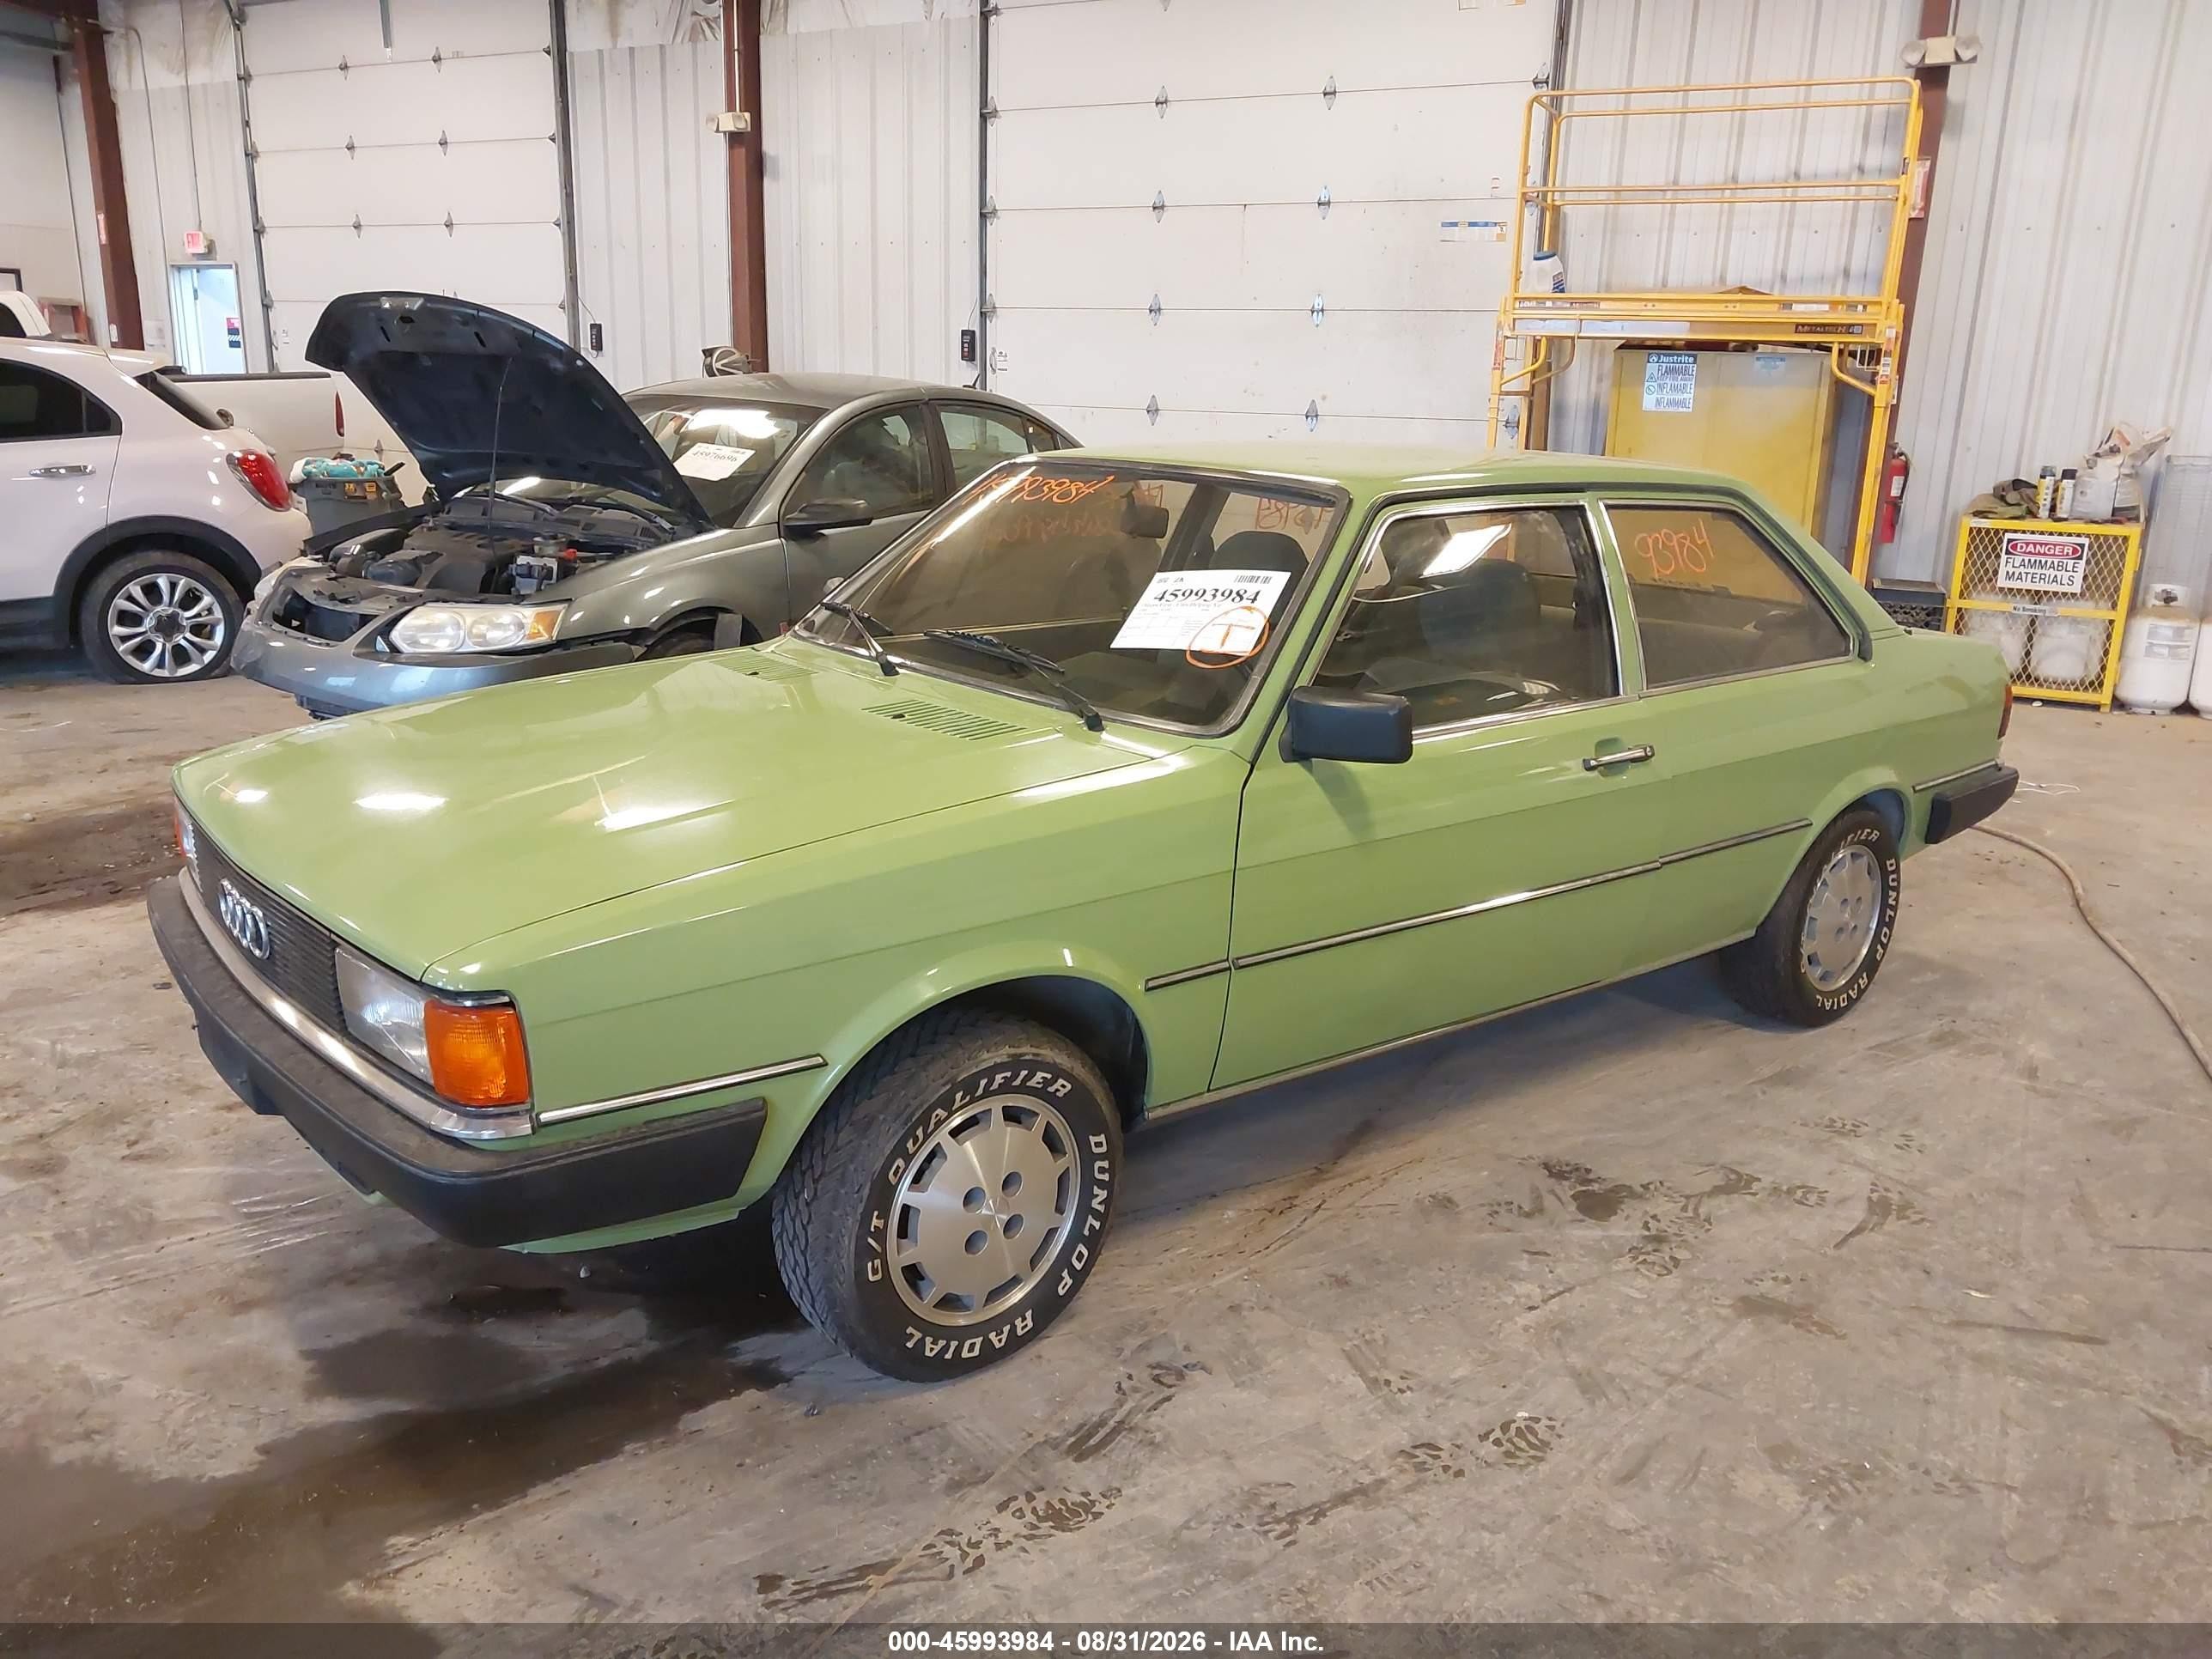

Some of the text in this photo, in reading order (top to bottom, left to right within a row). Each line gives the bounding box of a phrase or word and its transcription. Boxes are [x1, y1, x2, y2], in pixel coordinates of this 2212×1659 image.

[1658, 354, 1694, 363] Justrite
[1657, 364, 1695, 376] FLAMMABLE
[1656, 397, 1692, 409] INFLAMMABLE
[1634, 517, 1715, 579] 93984
[2016, 543, 2073, 556] DANGER
[2004, 557, 2081, 573] FLAMMABLE
[2004, 570, 2075, 586] MATERIALS
[1153, 587, 1261, 604] 45993984
[1815, 858, 1899, 1011] DUNLOP RADIAL
[887, 1069, 1073, 1186] QUALIFIER
[904, 1132, 1111, 1360] DUNLOP RADIAL
